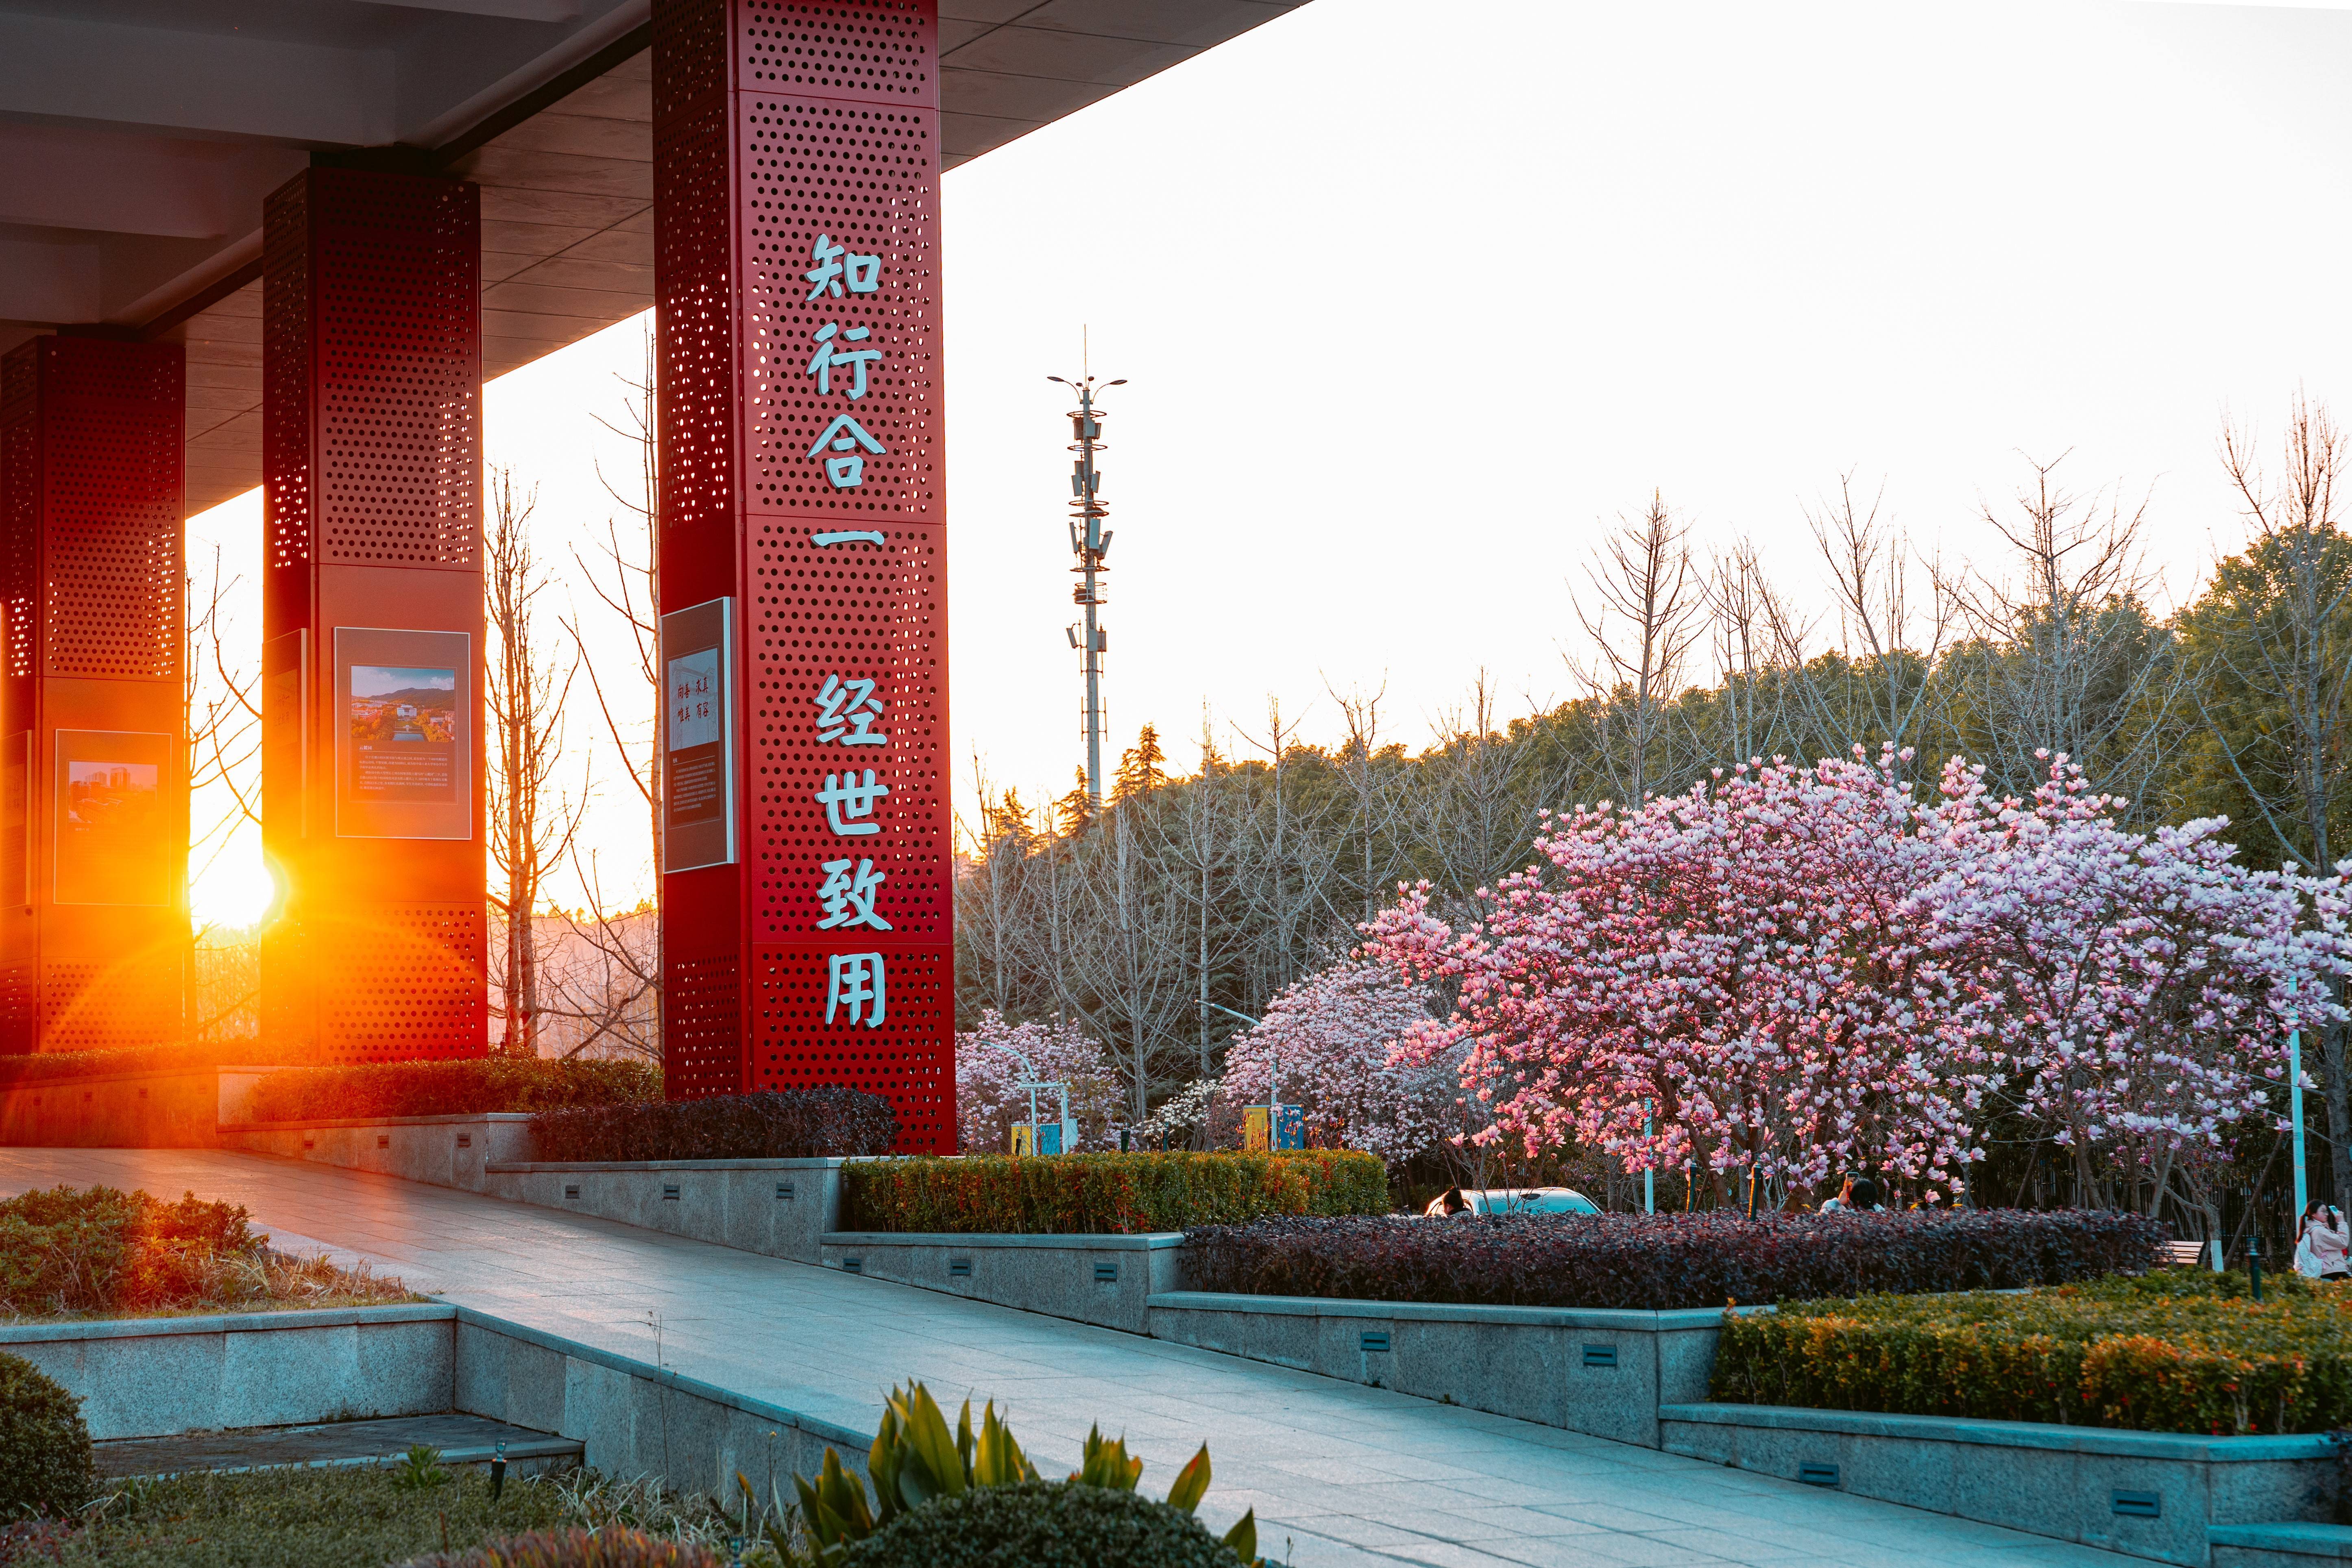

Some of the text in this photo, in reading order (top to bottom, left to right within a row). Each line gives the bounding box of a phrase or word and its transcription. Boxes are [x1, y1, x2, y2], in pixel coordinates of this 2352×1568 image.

[805, 233, 887, 546] 知行合一
[677, 701, 709, 723] 唯美 有容
[678, 676, 708, 699] 向善 求真
[814, 674, 893, 1029] 经世致用
